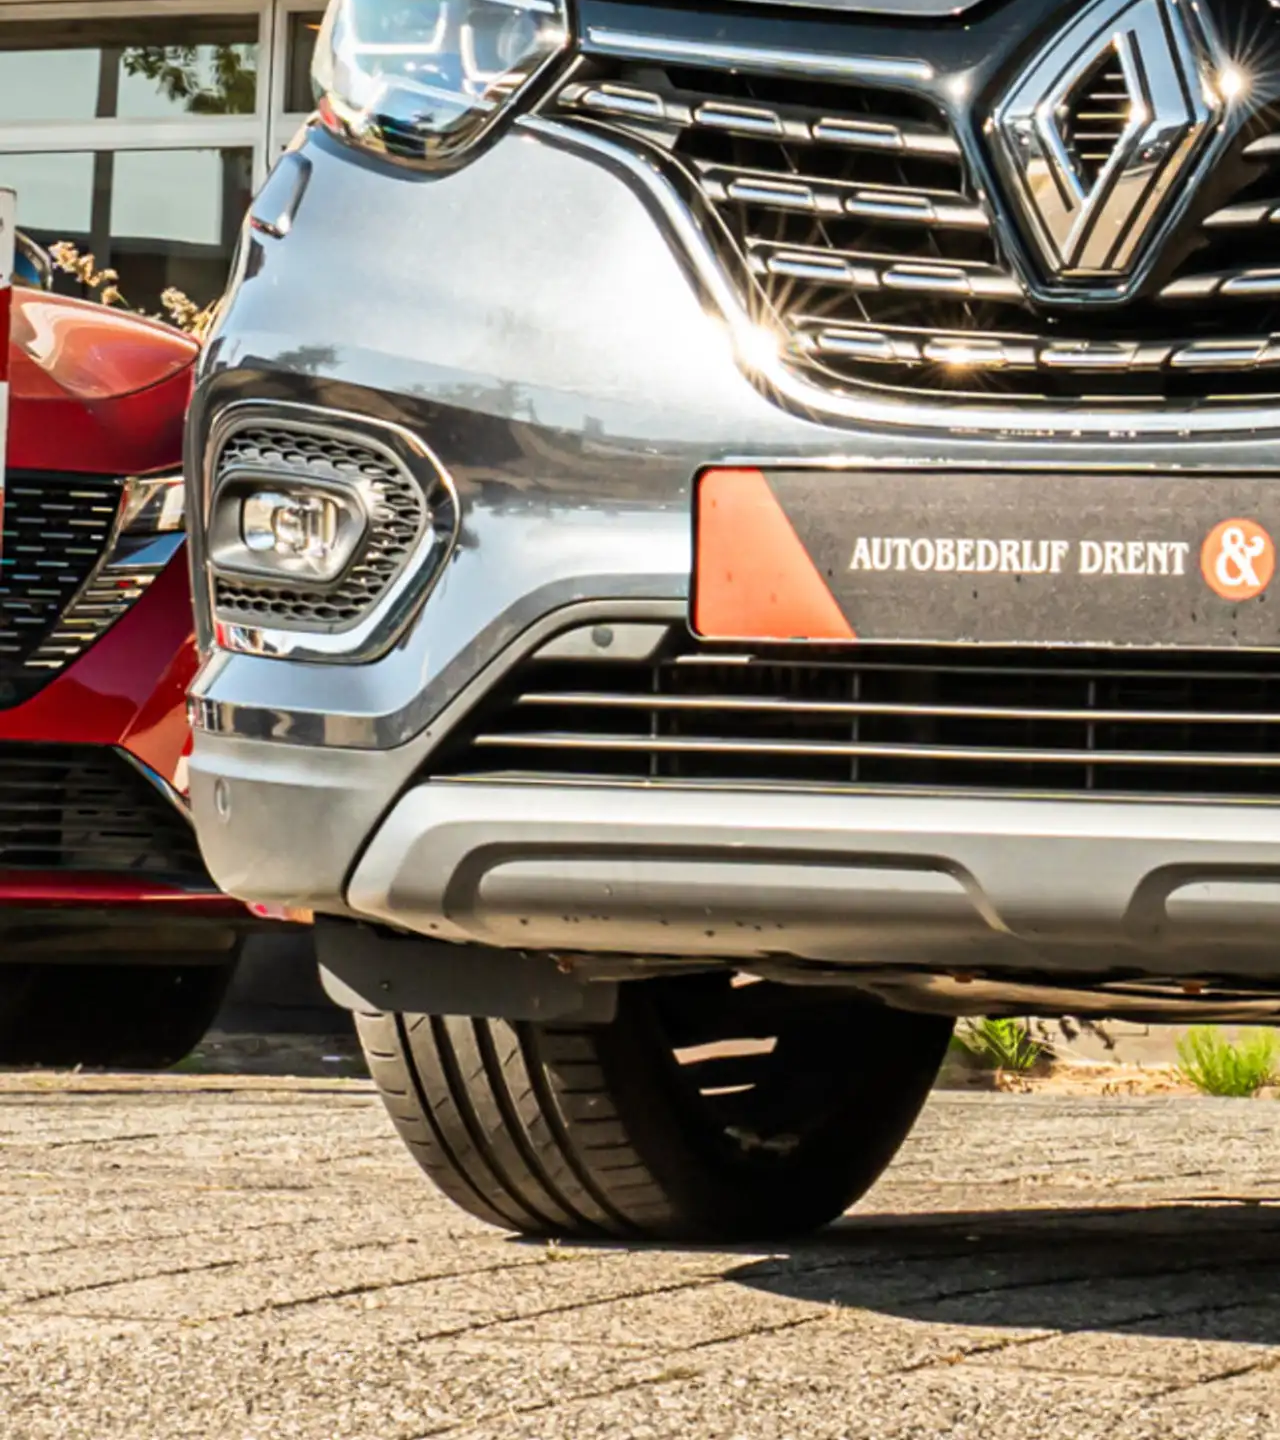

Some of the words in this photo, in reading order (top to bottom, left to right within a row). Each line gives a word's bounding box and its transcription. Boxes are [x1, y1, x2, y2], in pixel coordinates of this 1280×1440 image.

[849, 536, 1069, 575] AUTOBEDRIJF
[1078, 540, 1189, 576] DRENT
[1215, 526, 1266, 587] &
